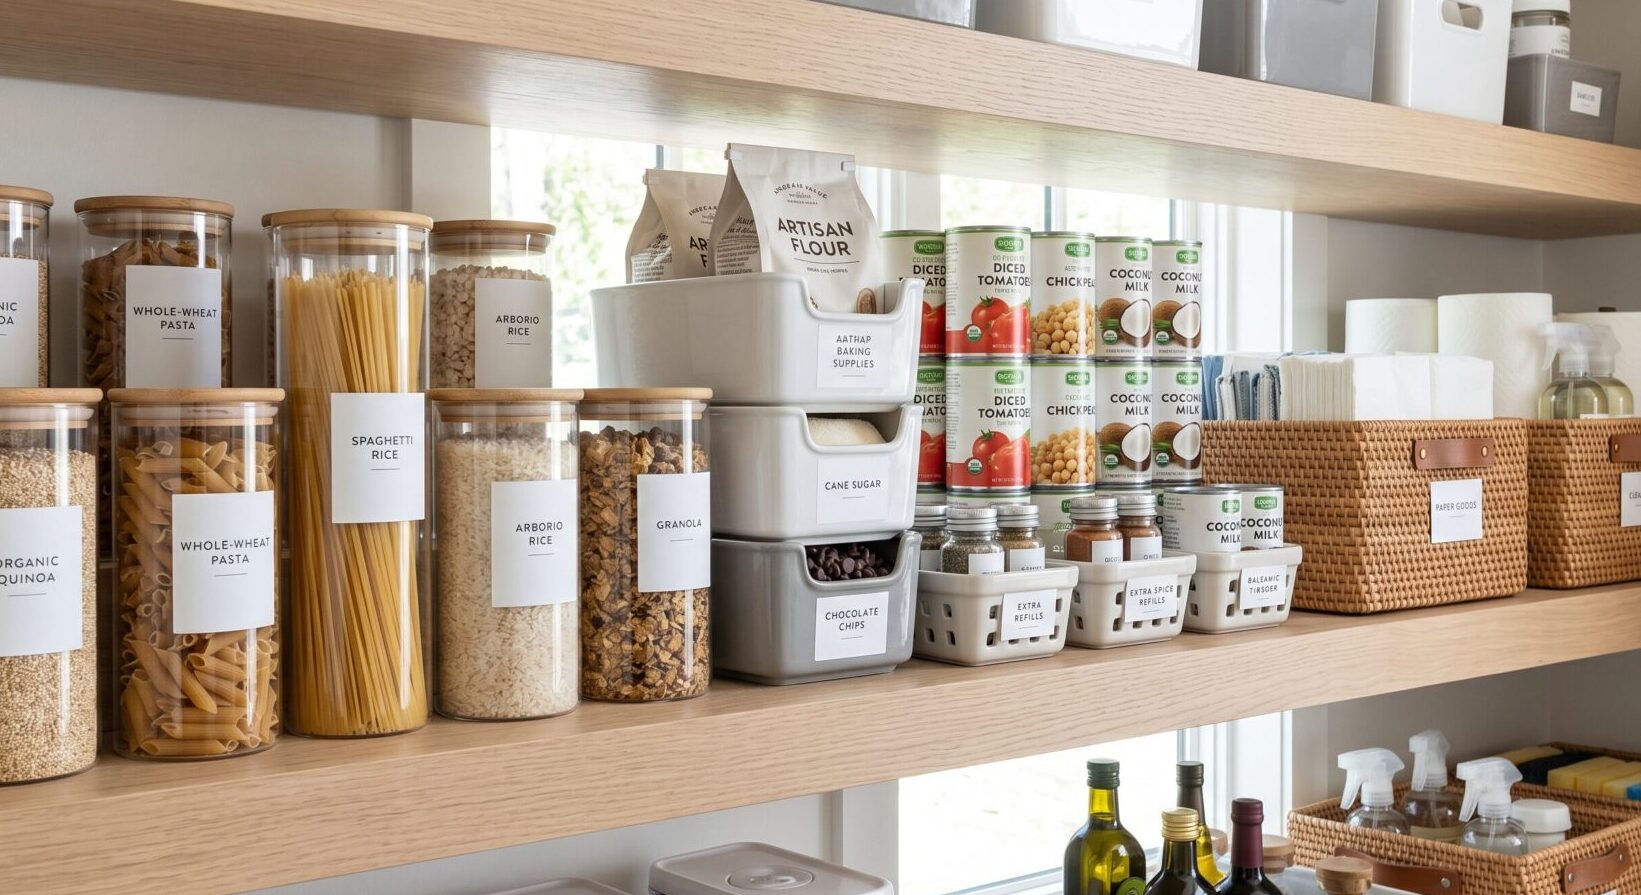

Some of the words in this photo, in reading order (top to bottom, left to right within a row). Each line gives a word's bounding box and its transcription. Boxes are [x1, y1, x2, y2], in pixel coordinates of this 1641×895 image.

[778, 217, 854, 237] ARTISAN
[790, 237, 851, 256] FLOUR
[994, 263, 1026, 274] DICED
[1125, 281, 1149, 292] MILK
[1175, 284, 1199, 294] MILK
[133, 306, 217, 319] WHOLE-WHEAT
[160, 319, 196, 331] PASTA
[495, 314, 540, 325] ARBORIO
[508, 327, 529, 336] RICE
[836, 334, 872, 345] AATHAP
[837, 347, 871, 357] BAKING
[833, 359, 875, 369] SUPPLIES
[994, 396, 1026, 406] DICED
[1125, 406, 1149, 416] MILK
[1176, 405, 1200, 415] MILK
[351, 435, 413, 447] SPAGHETTI
[371, 449, 399, 460] RICE
[825, 480, 850, 490] CANE
[852, 479, 881, 489] SUGAR
[1435, 503, 1455, 512] PAPER
[1456, 501, 1477, 511] GOODS
[515, 521, 563, 533] ARBORIO
[656, 518, 702, 530] GRANOLA
[529, 535, 553, 546] RICE
[1220, 534, 1241, 544] MILK
[1254, 530, 1279, 540] MILK
[180, 536, 270, 552] WHOLE-WHEAT
[211, 553, 250, 566] PASTA
[0, 573, 56, 586] QUINOA
[1247, 574, 1280, 585] BALEAMIC
[1130, 587, 1152, 597] EXTRA
[1153, 585, 1174, 595] SPICE
[1017, 600, 1042, 611] EXTRA
[1138, 596, 1166, 607] REFILLS
[825, 607, 879, 620] CHOCOLATE
[1014, 611, 1044, 622] REFILLS
[838, 620, 865, 632] CHIPS
